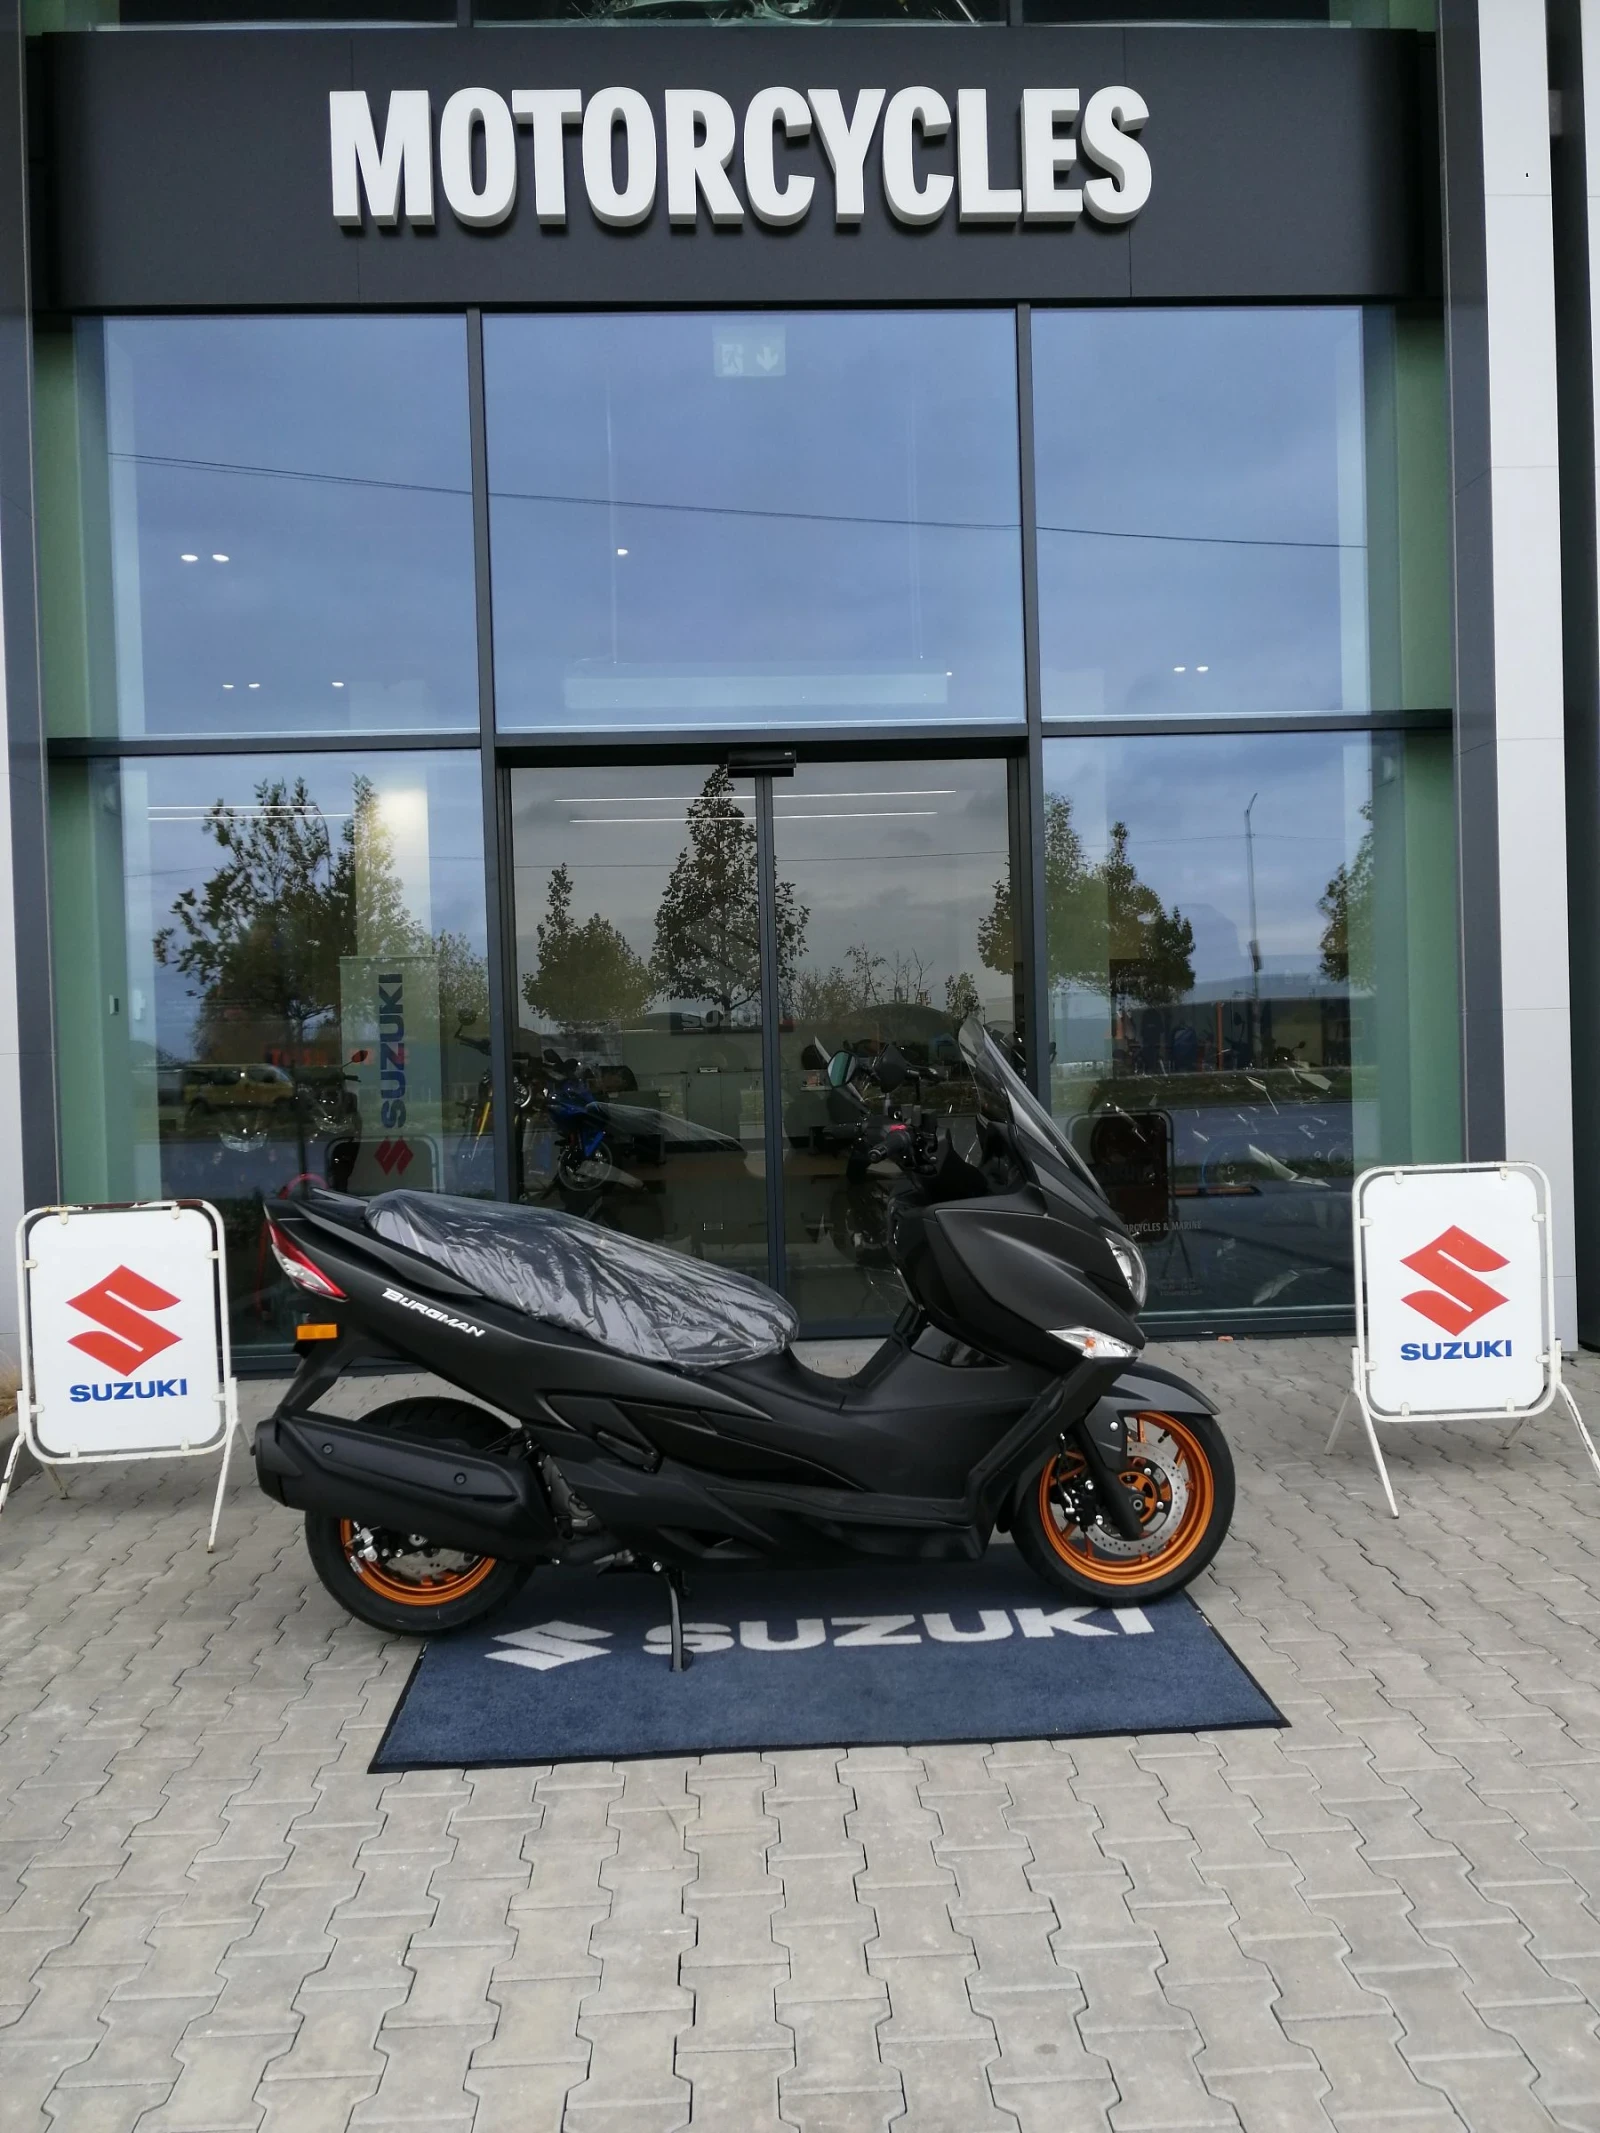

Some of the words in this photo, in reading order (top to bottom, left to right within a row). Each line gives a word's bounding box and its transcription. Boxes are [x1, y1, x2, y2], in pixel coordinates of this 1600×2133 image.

[329, 86, 1152, 228] MOTORCYCLES
[681, 1010, 783, 1028] SUZU
[379, 973, 407, 1129] SUZUKI
[1163, 1221, 1169, 1231] &
[1171, 1220, 1202, 1231] MARINE
[382, 1287, 486, 1338] BURGMAN
[1400, 1339, 1513, 1361] SUZUKI
[69, 1378, 188, 1403] SUZUKI
[642, 1606, 1155, 1655] SUZUKI
